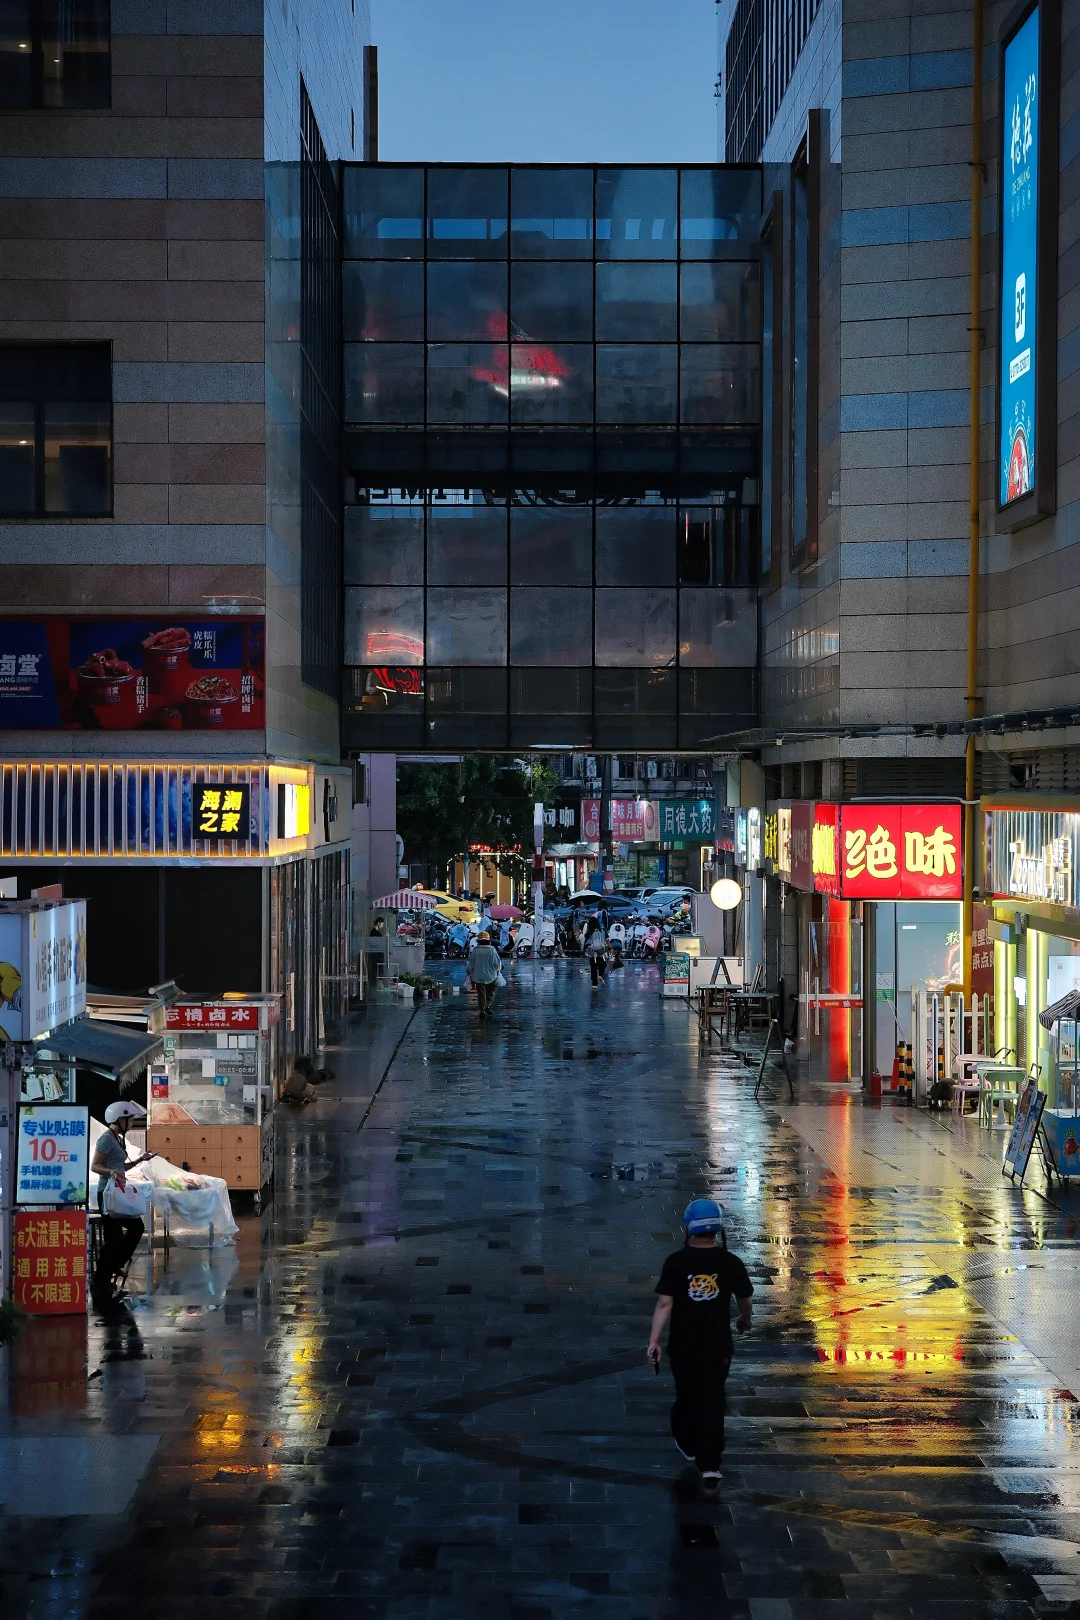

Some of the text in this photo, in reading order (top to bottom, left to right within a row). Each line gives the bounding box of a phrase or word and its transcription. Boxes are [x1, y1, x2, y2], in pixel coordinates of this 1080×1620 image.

[1016, 286, 1025, 329] 3F
[193, 630, 203, 650] 虎皮
[200, 790, 243, 810] 海澜
[200, 812, 240, 832] 之家
[663, 804, 716, 835] 同德大药
[844, 824, 957, 879] 绝味
[22, 1120, 86, 1136] 专业贴膜
[21, 1165, 63, 1176] 手机维修
[20, 1179, 62, 1190] 爆屏修复
[17, 1220, 86, 1248] 有大流量卡出售
[17, 1256, 85, 1278] 通用流量
